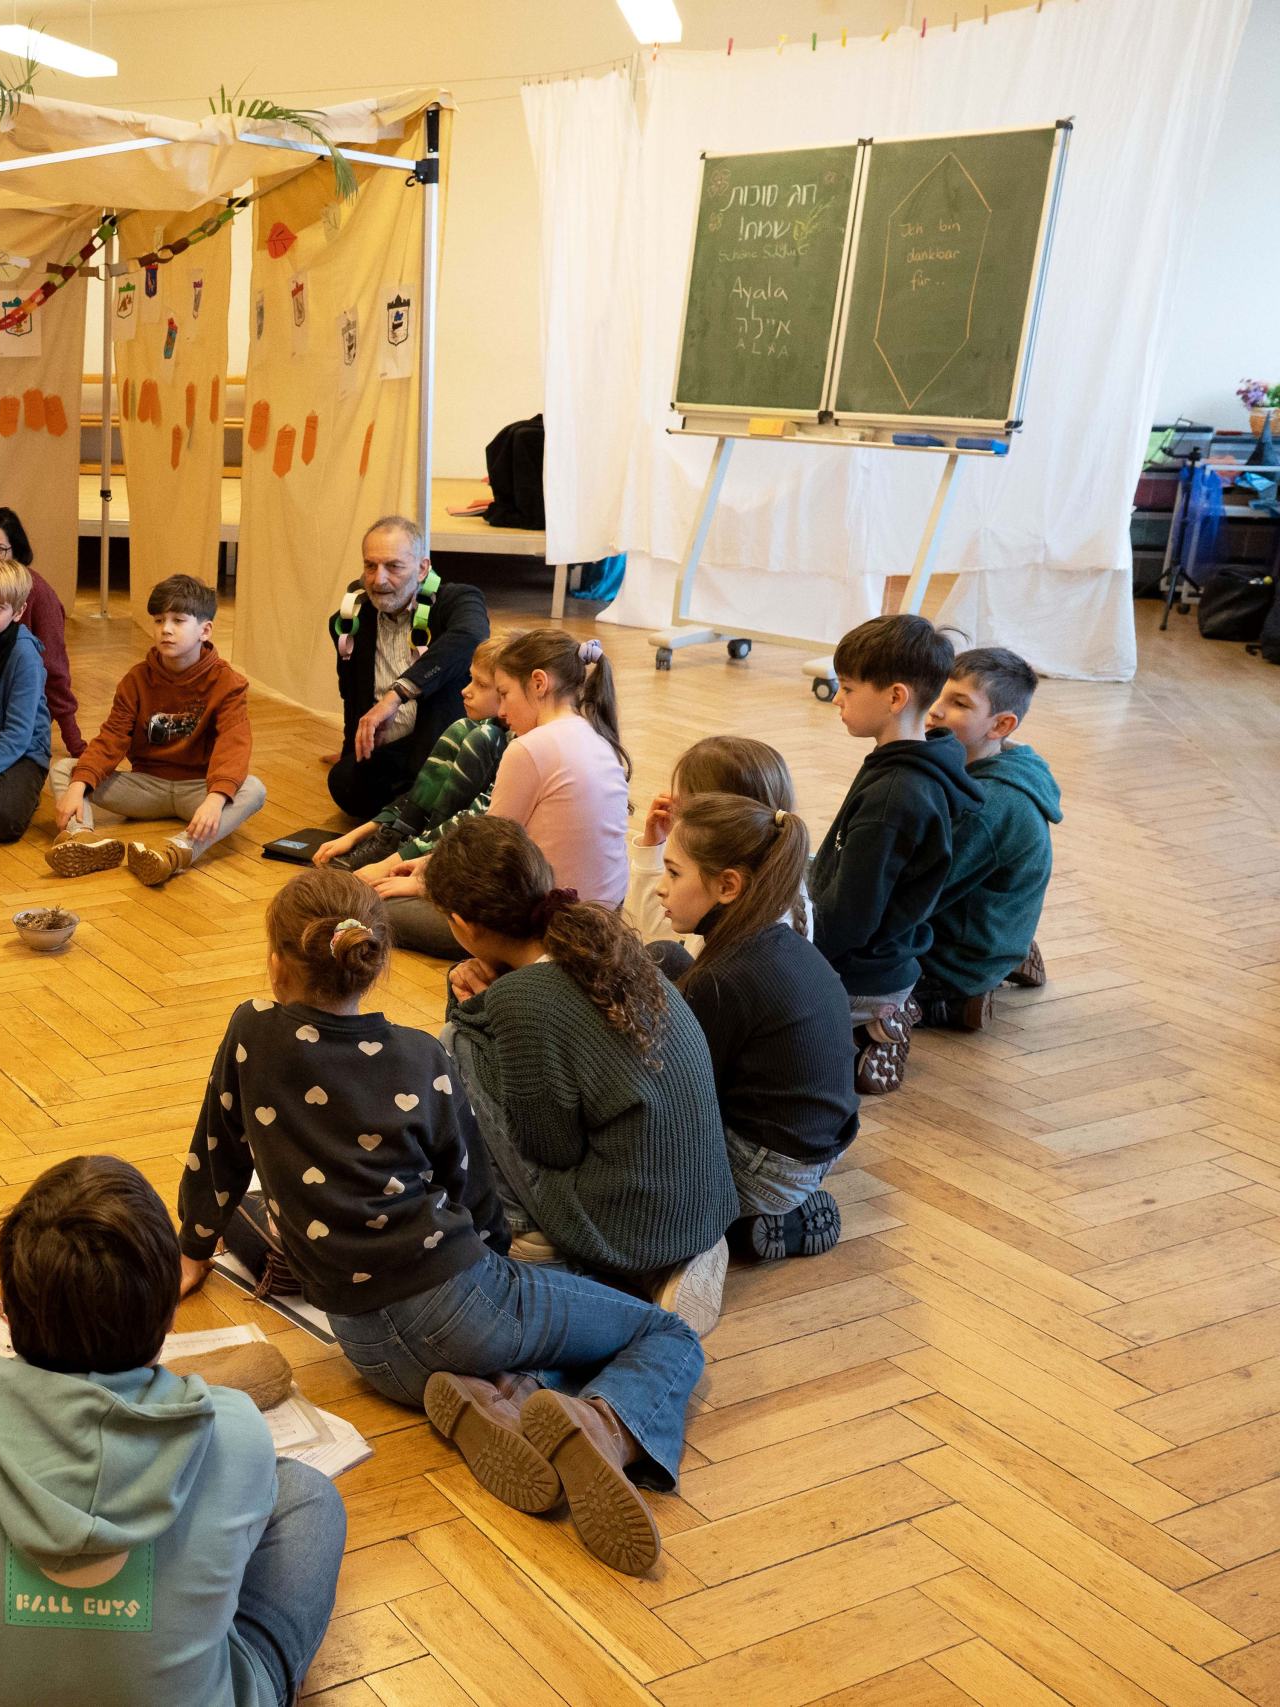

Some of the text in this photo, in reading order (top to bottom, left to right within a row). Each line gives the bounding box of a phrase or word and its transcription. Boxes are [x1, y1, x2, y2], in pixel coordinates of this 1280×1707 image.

[720, 183, 817, 212] חג סוכות
[939, 218, 961, 233] bin
[906, 246, 961, 264] dankbar
[728, 275, 789, 309] Ayala
[15, 1593, 142, 1618] BALL GUYS
